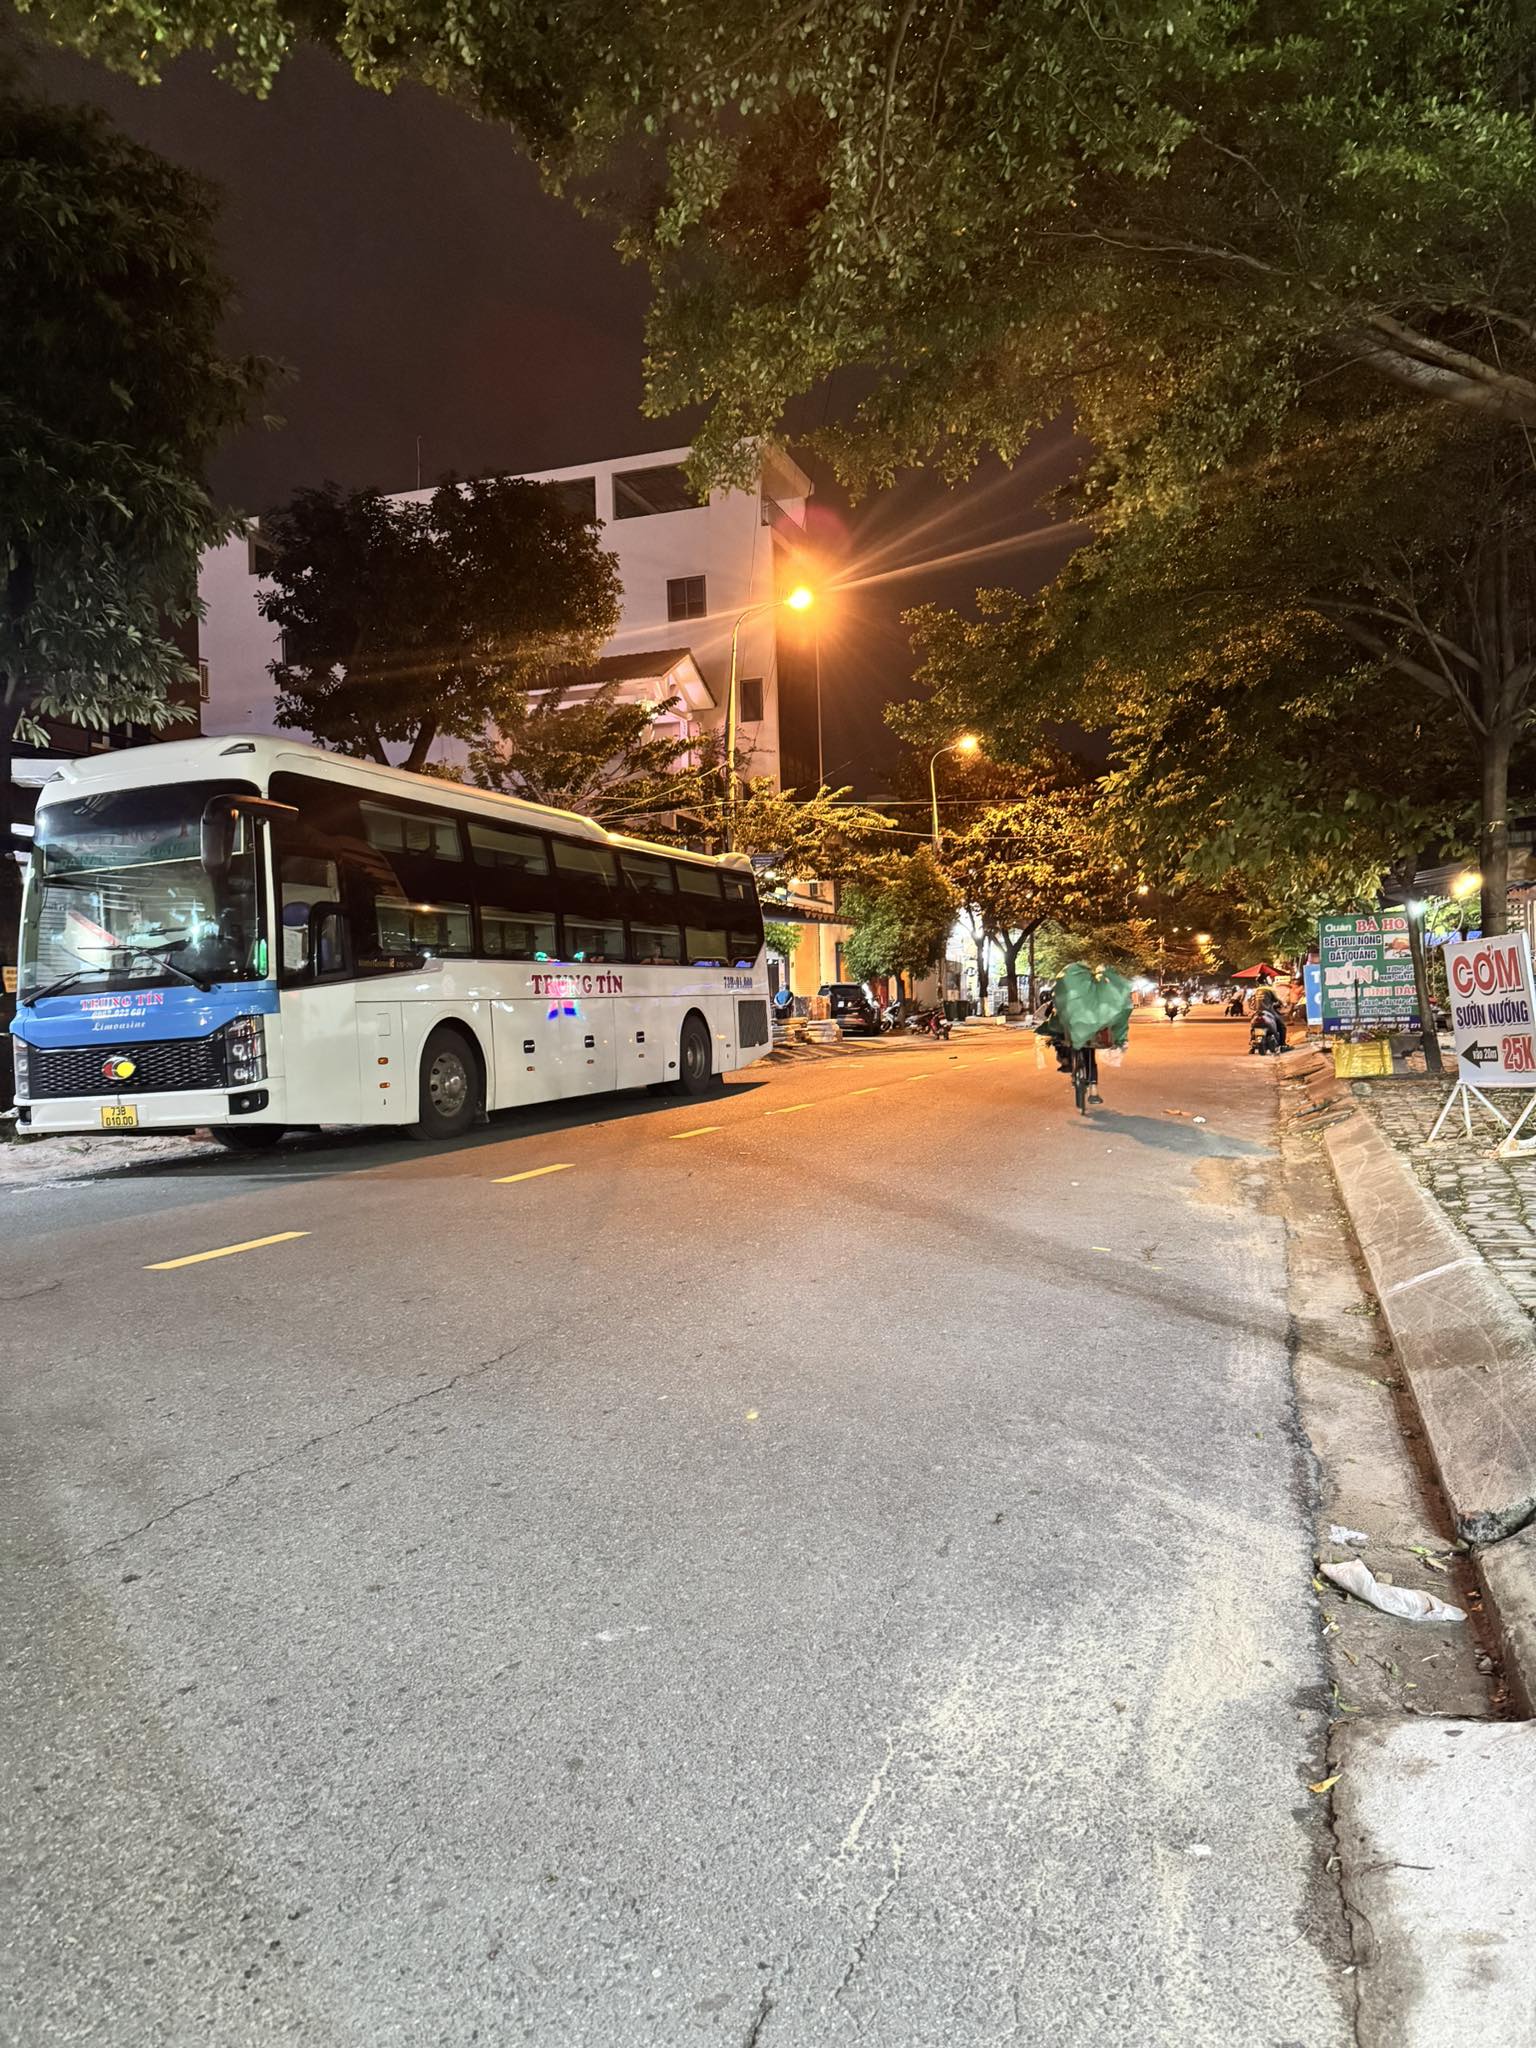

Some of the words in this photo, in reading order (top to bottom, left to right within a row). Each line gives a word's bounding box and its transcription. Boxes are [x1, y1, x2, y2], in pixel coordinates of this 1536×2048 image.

[1356, 915, 1380, 932] BÀ
[1382, 917, 1409, 931] HO
[1337, 935, 1356, 947] THUI
[1452, 944, 1524, 996] CƠM
[532, 974, 592, 994] TRUNG
[596, 969, 624, 993] TÍN
[80, 995, 132, 1011] TRUNG
[135, 990, 165, 1006] TÍN
[1456, 1000, 1486, 1027] SƯỜN
[1488, 997, 1530, 1025] NƯỚNG
[91, 1020, 147, 1032] Limousine
[1501, 1035, 1536, 1071] 25K
[105, 1115, 134, 1126] 010.00
[110, 1106, 126, 1116] 73B
